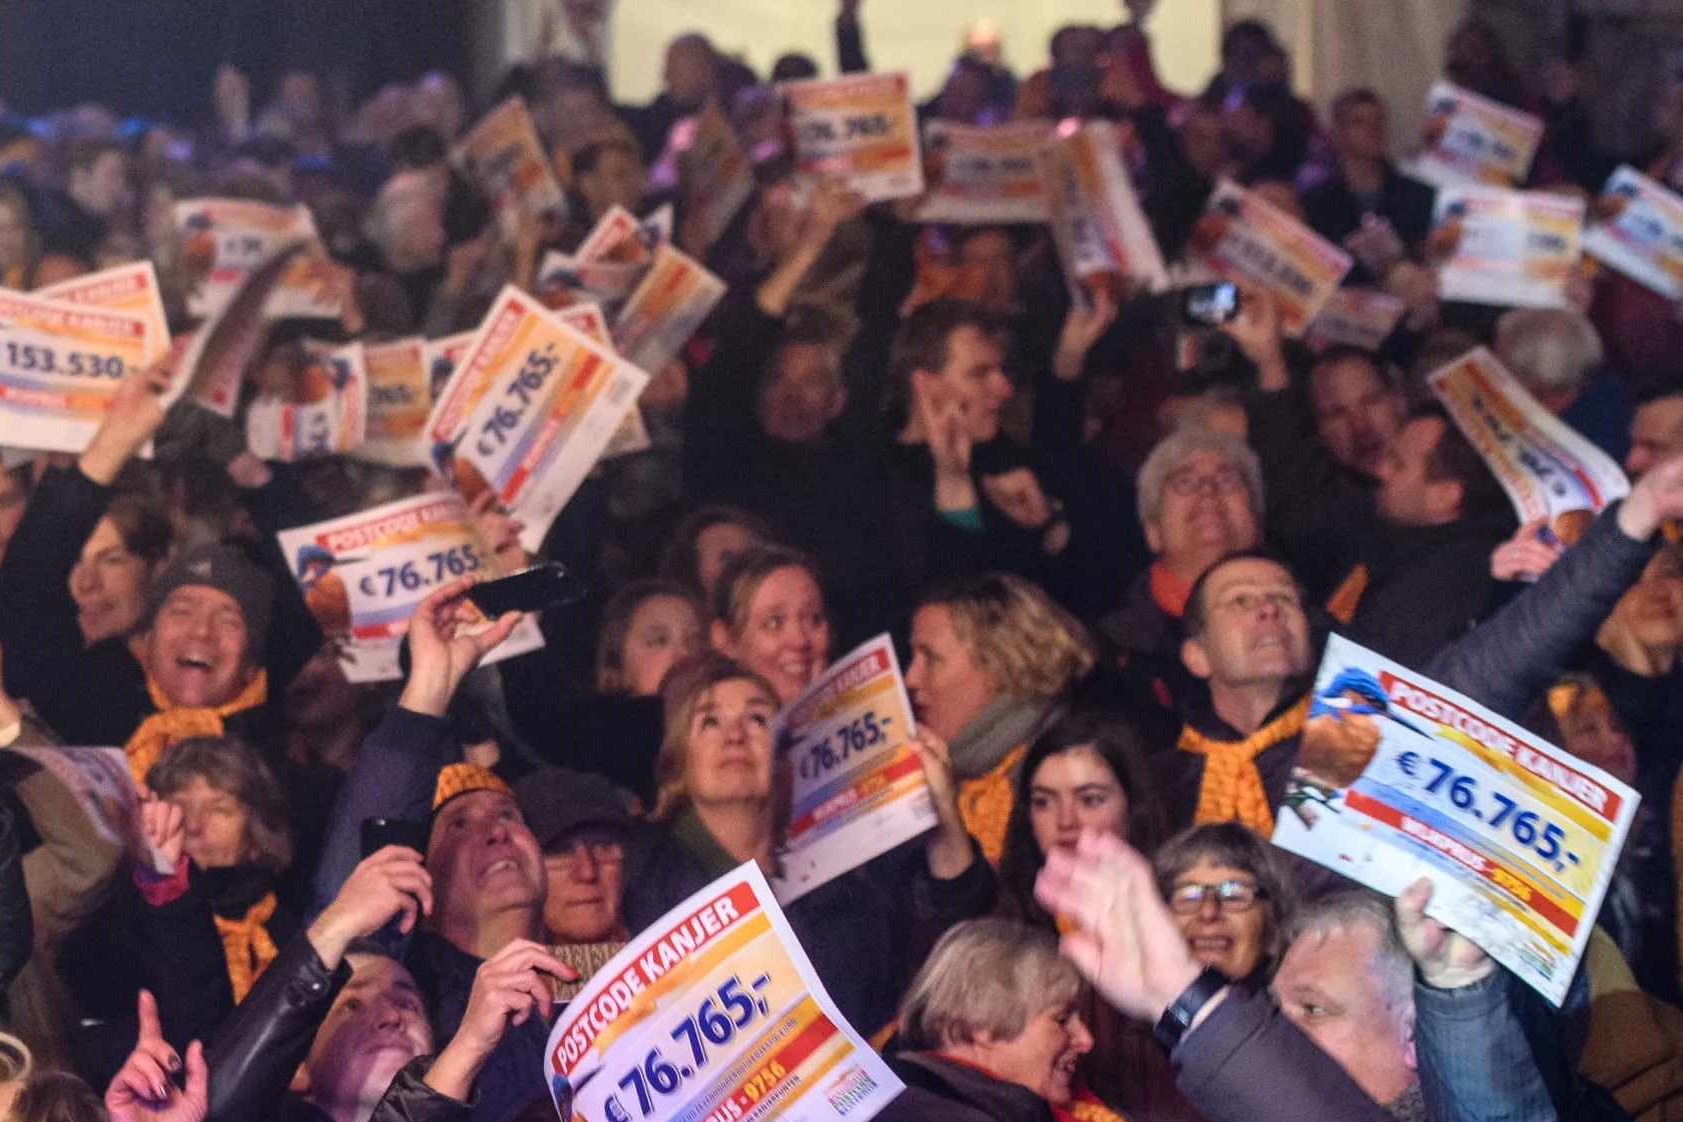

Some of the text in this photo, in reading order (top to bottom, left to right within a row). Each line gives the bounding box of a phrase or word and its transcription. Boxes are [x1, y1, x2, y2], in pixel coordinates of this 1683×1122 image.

[1389, 679, 1611, 814] POSTCODE KANJER
[556, 896, 740, 1072] POSTCODE KANJER
[744, 1062, 789, 1101] 9756
